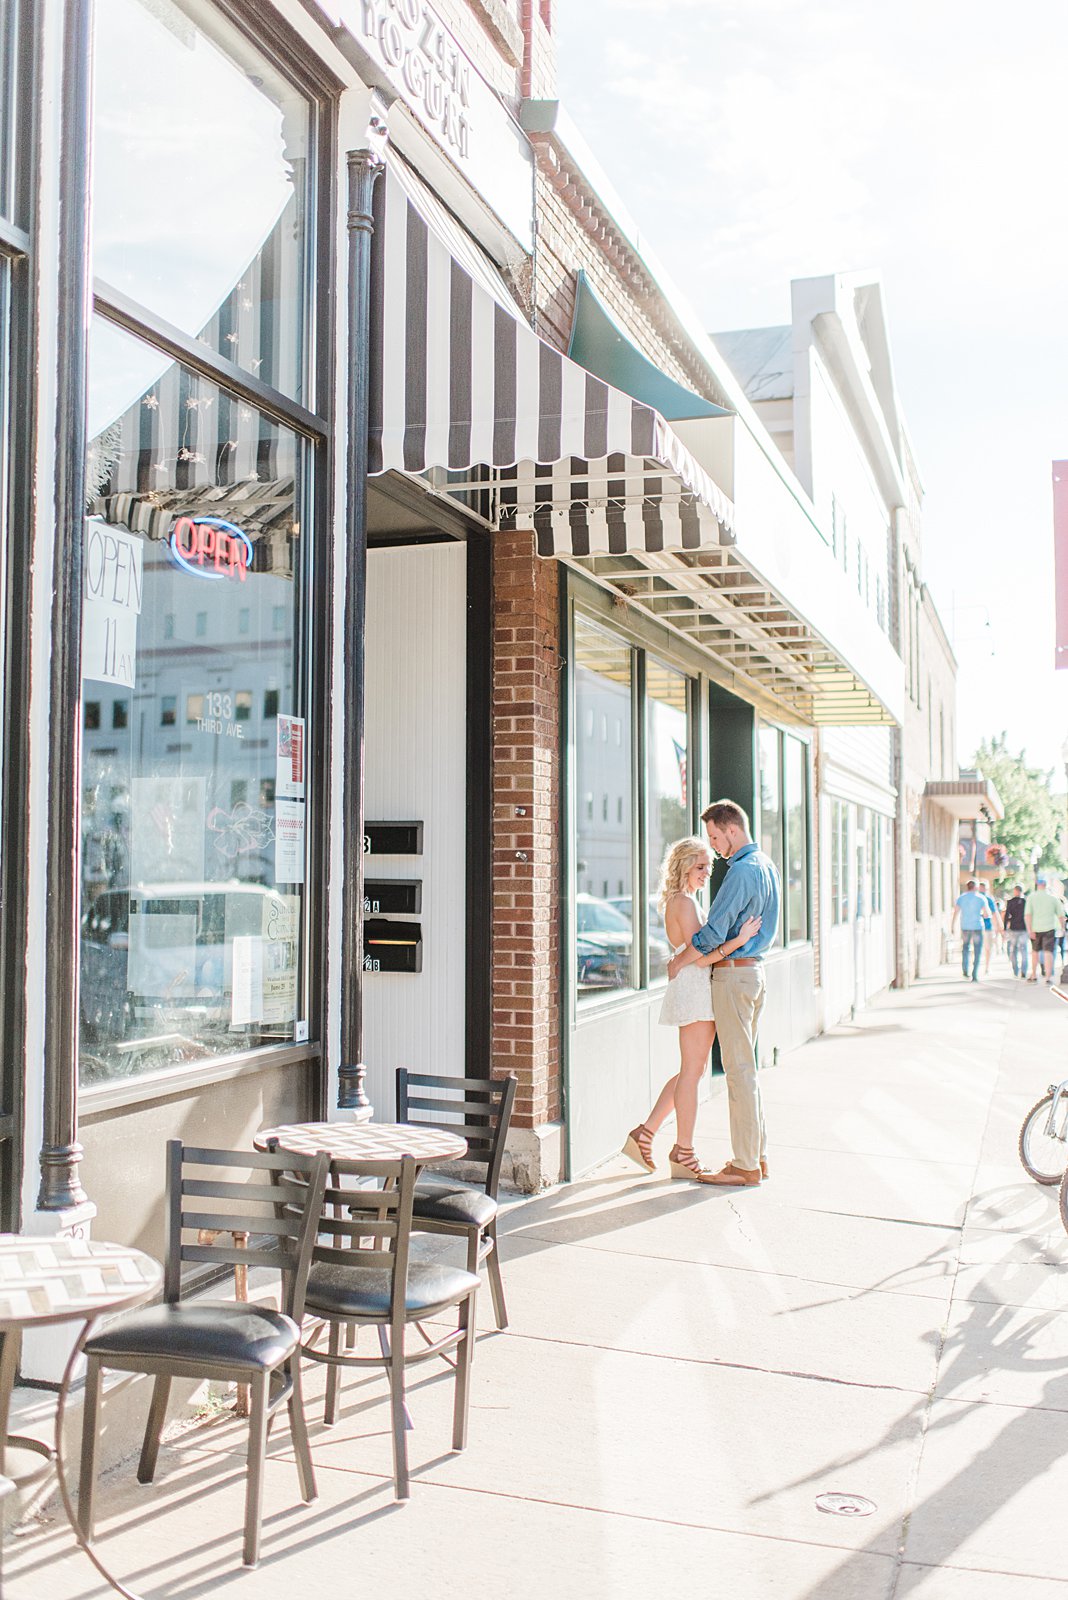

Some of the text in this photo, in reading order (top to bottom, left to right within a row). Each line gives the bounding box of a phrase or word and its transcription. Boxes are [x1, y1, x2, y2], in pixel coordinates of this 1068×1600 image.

[88, 530, 142, 611] OPEN
[175, 516, 248, 582] OPEN
[195, 716, 245, 739] THIRD AVE.
[206, 692, 232, 720] 133
